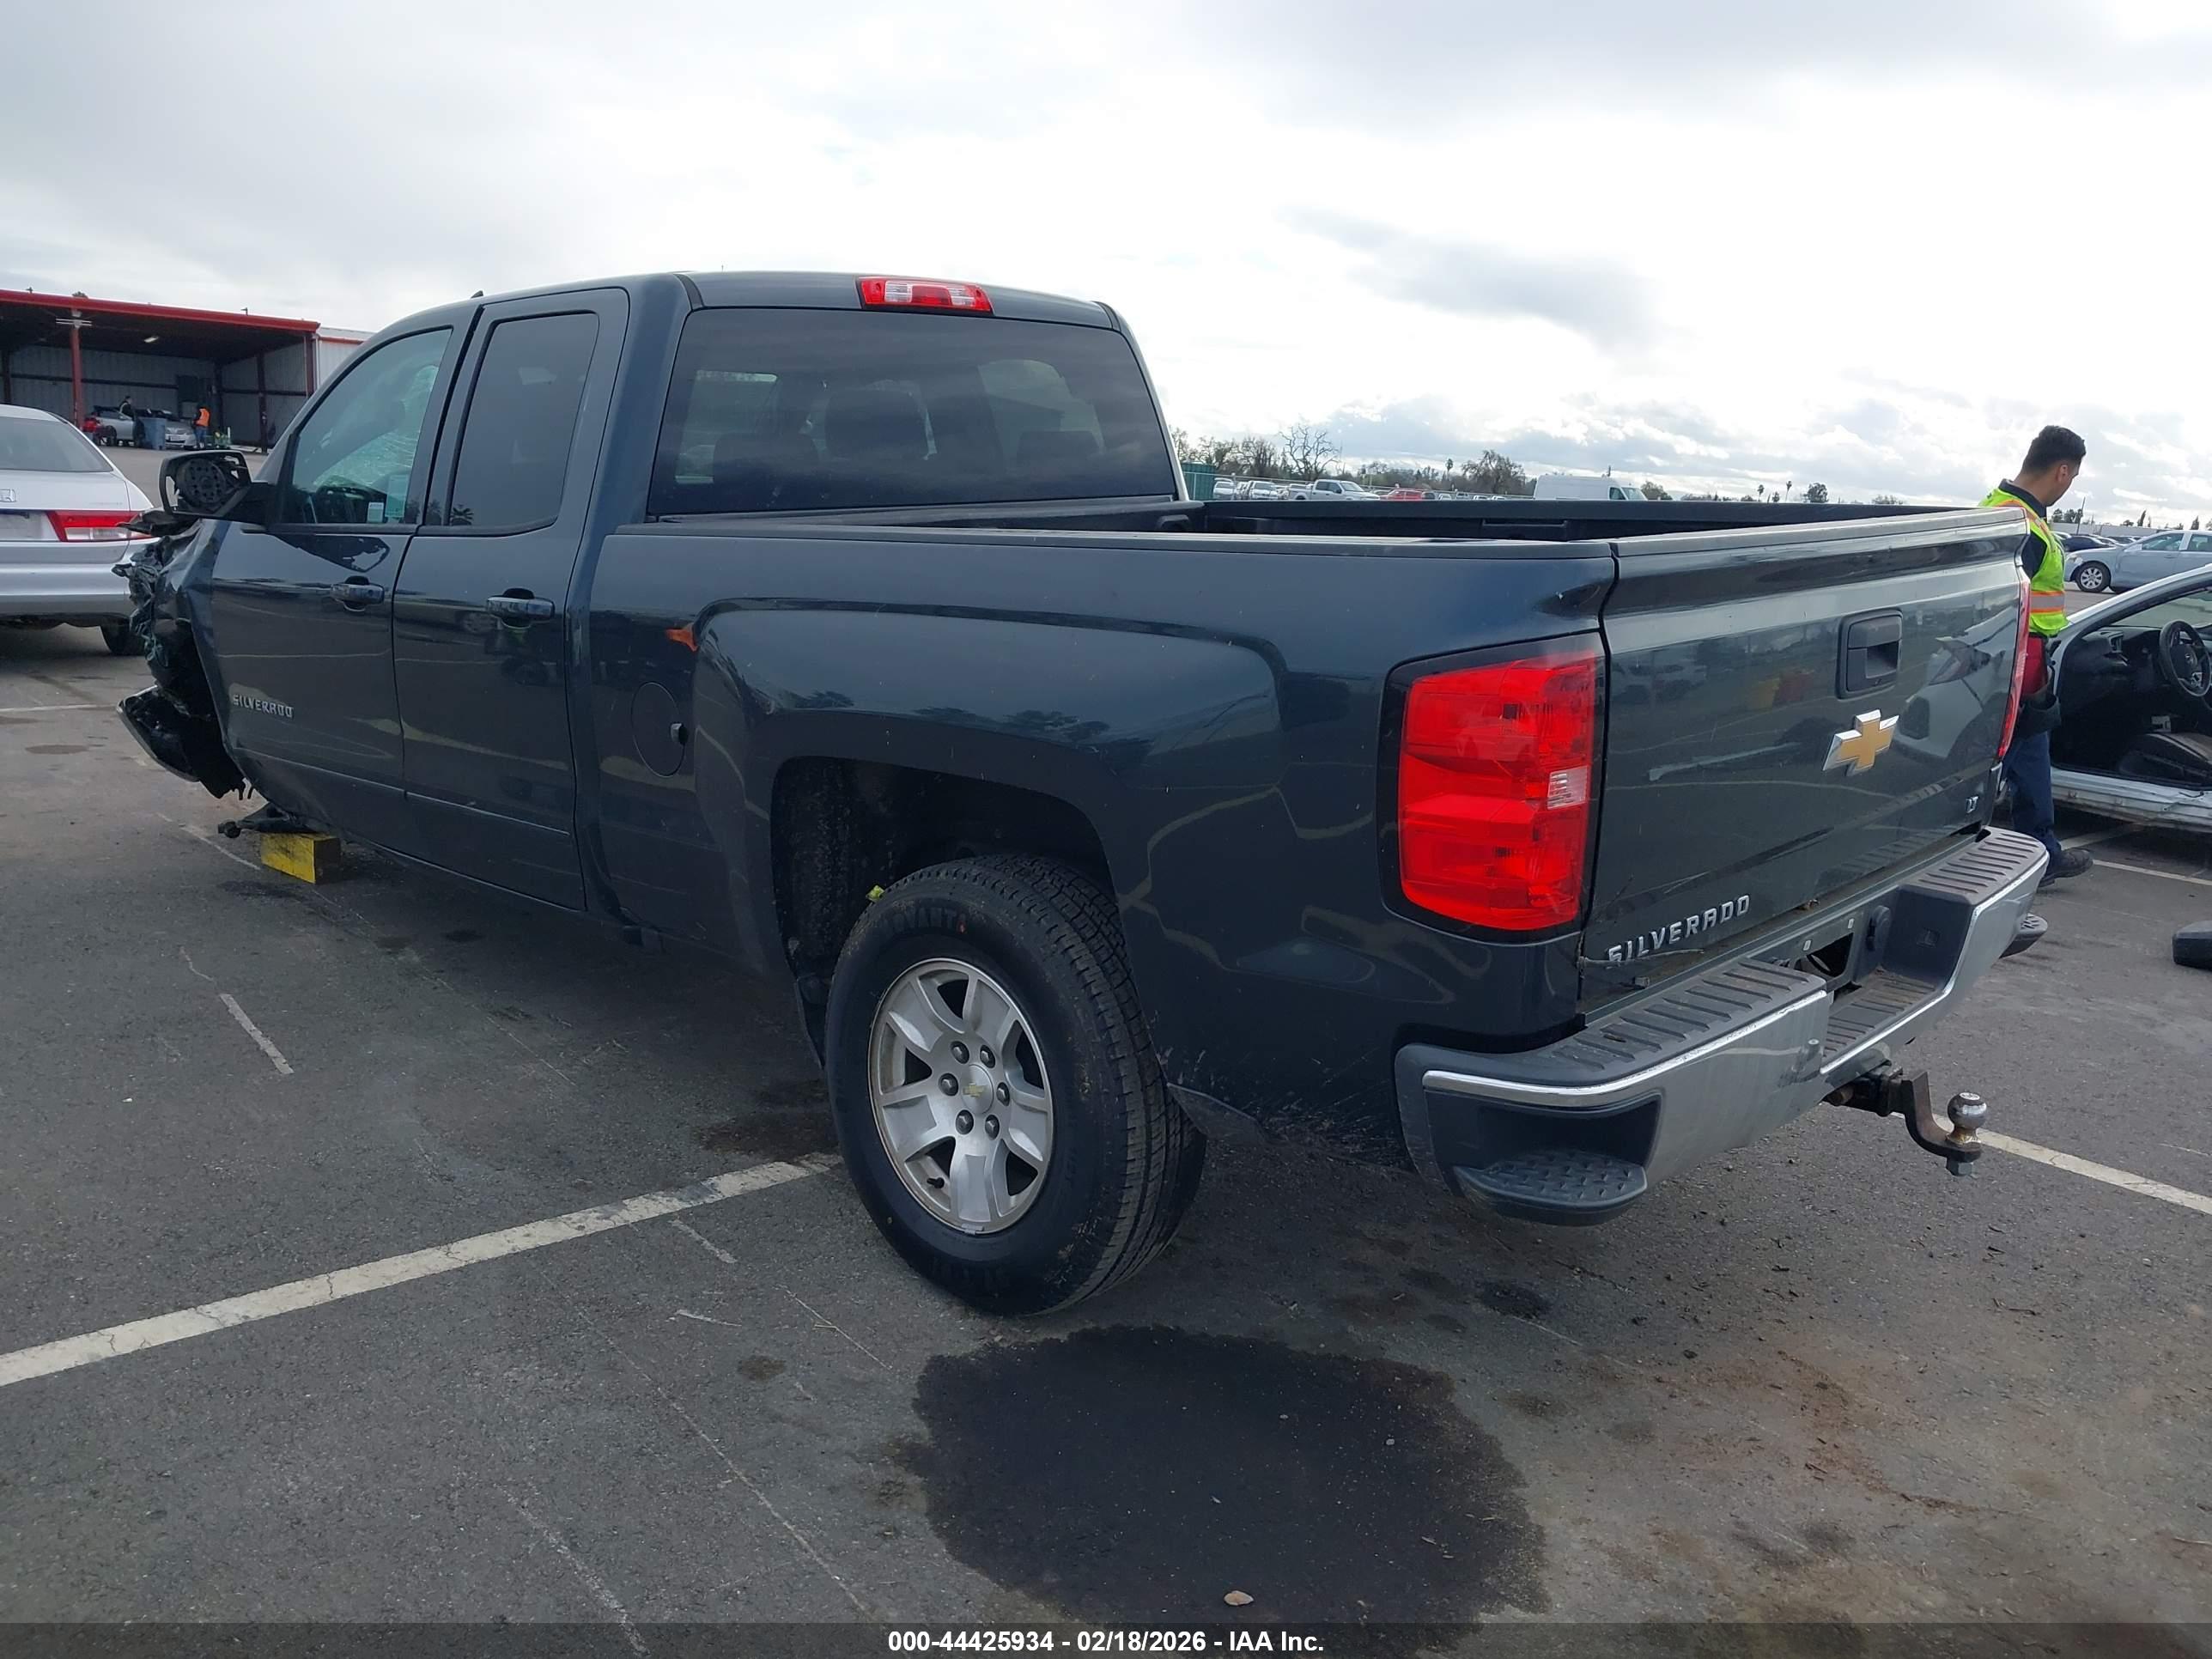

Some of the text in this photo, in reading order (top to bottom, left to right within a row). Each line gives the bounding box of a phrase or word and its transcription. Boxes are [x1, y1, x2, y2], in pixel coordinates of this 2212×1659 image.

[233, 694, 295, 719] SILVERADO
[1965, 795, 1979, 814] LT
[1605, 894, 1751, 969] SILVERADO
